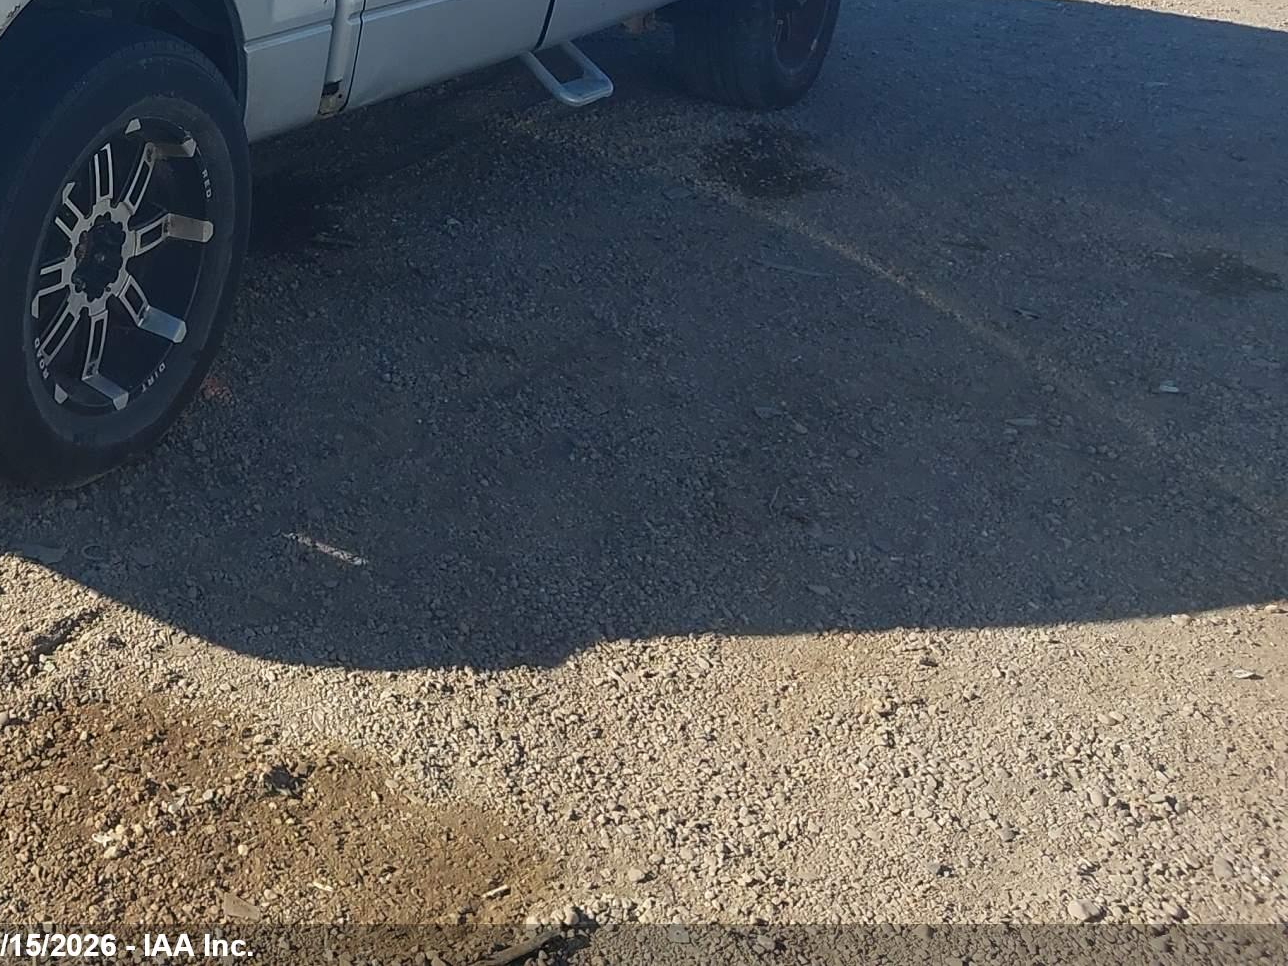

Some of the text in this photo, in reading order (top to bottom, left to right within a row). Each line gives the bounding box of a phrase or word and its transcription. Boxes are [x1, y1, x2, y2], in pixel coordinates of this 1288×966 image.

[34, 168, 212, 394] RED DIRT ROAD
